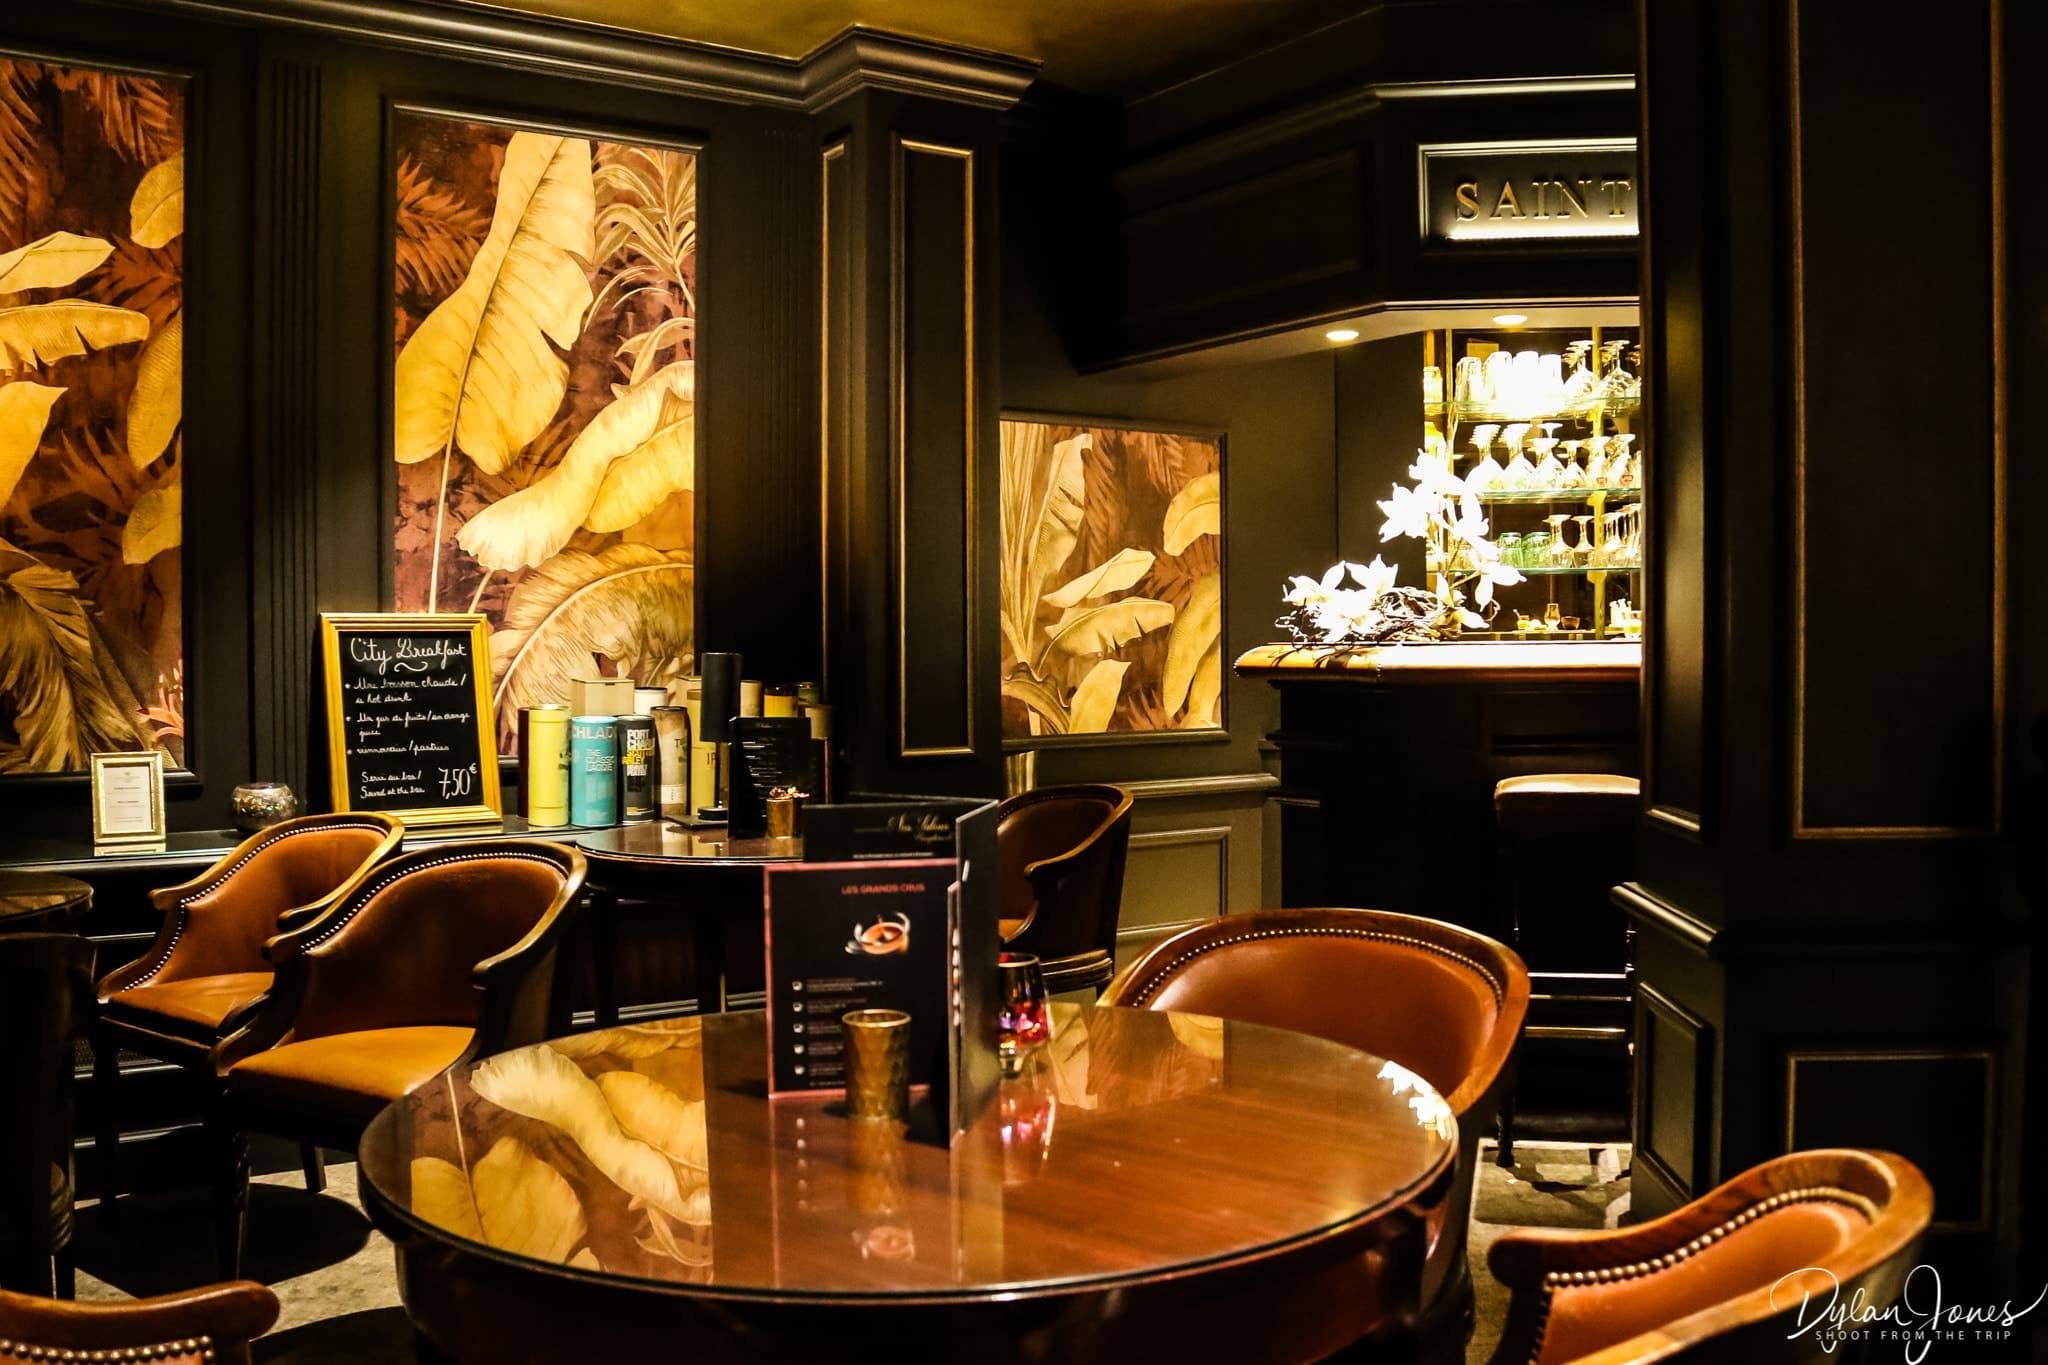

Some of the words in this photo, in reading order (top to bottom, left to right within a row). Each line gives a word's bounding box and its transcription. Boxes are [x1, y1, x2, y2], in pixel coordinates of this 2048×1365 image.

[1455, 179, 1632, 222] SAINT
[351, 637, 392, 675] City
[396, 637, 467, 670] Breakfast
